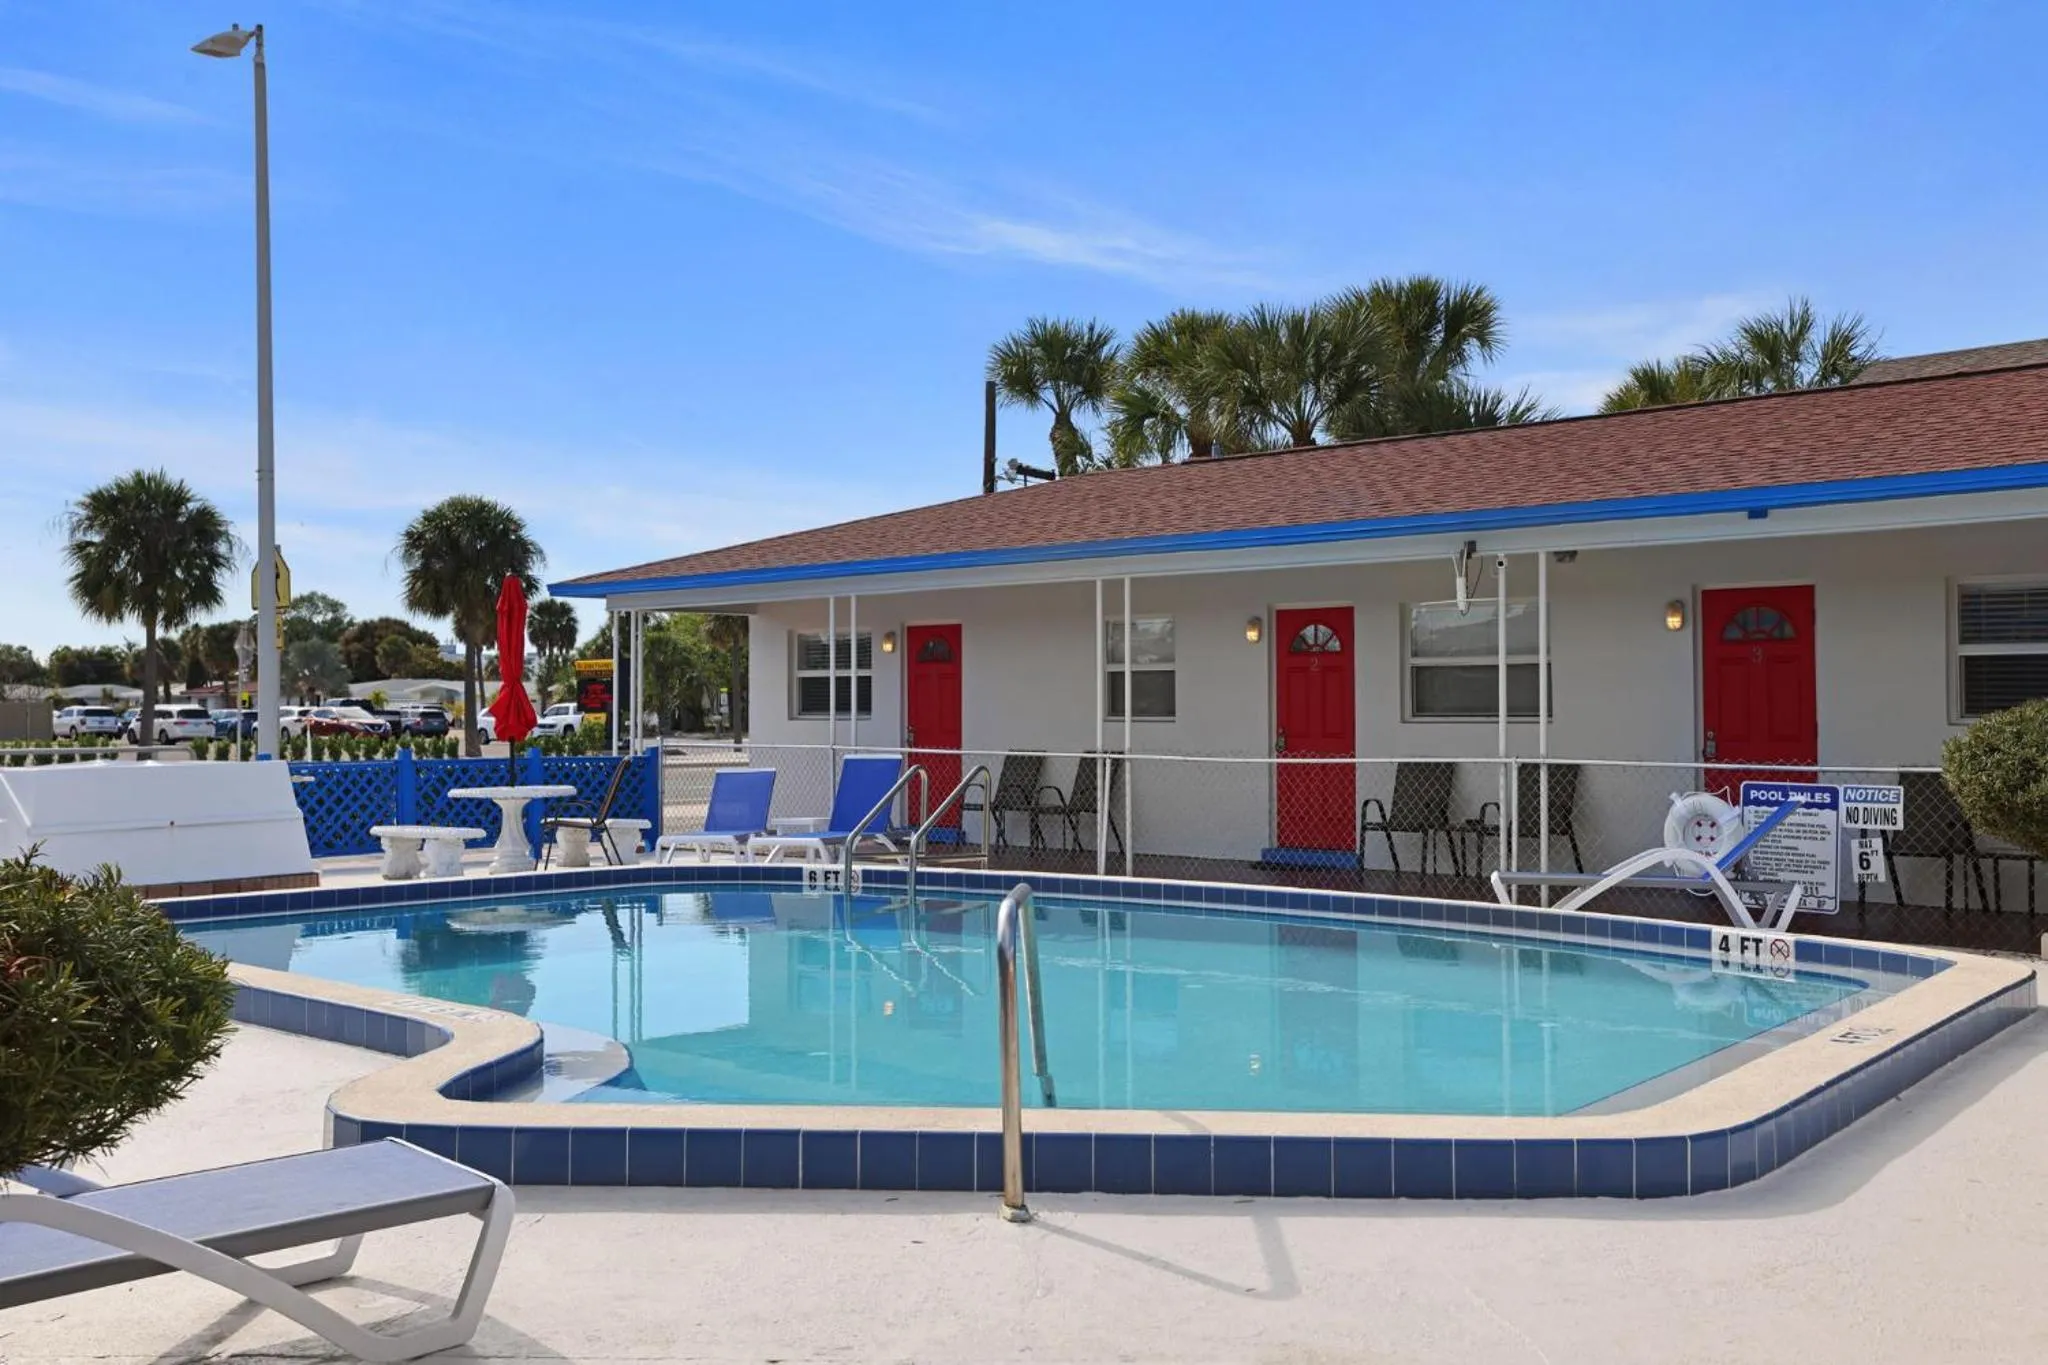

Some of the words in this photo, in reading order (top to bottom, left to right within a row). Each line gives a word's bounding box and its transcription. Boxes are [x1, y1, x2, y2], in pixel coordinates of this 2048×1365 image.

[1749, 790, 1786, 801] POOL
[1846, 788, 1900, 802] NOTICE
[1845, 806, 1859, 824] NO
[1863, 807, 1897, 826] DIVING
[1858, 851, 1871, 871] 6
[824, 870, 840, 883] FT
[1719, 934, 1731, 953] 4
[1740, 935, 1763, 956] FT
